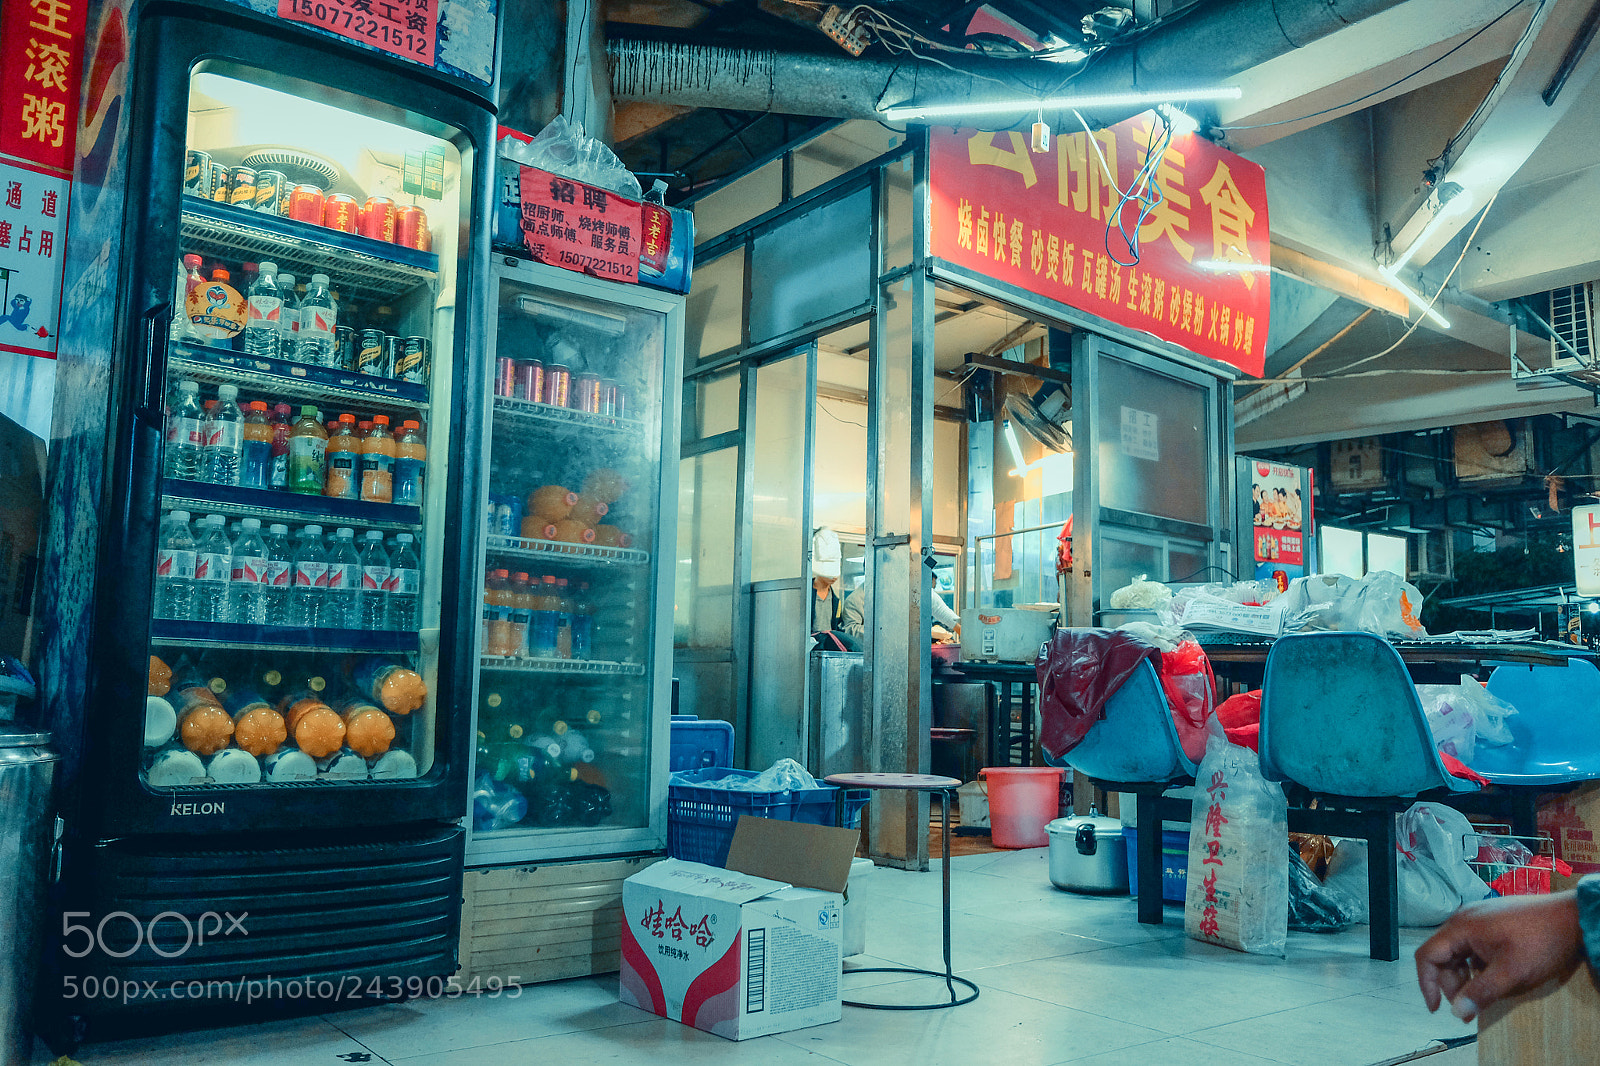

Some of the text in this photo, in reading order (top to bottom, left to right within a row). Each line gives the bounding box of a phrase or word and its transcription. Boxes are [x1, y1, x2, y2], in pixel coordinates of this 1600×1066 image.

[291, 0, 427, 55] 15077221512
[22, 0, 71, 147] 生滚粥
[550, 178, 608, 214] 招聘
[646, 210, 661, 257] 王老吉
[560, 250, 633, 277] 15077221512
[957, 197, 1024, 269] 烧卤快餐
[1030, 229, 1075, 288] 砂煲饭
[1081, 249, 1122, 305] 瓦罐汤
[1127, 267, 1165, 322] 生滚粥
[1170, 284, 1205, 336] 砂煲粉
[1207, 300, 1231, 347] 火锅
[170, 801, 225, 816] KELON
[640, 898, 713, 948] 娃哈哈
